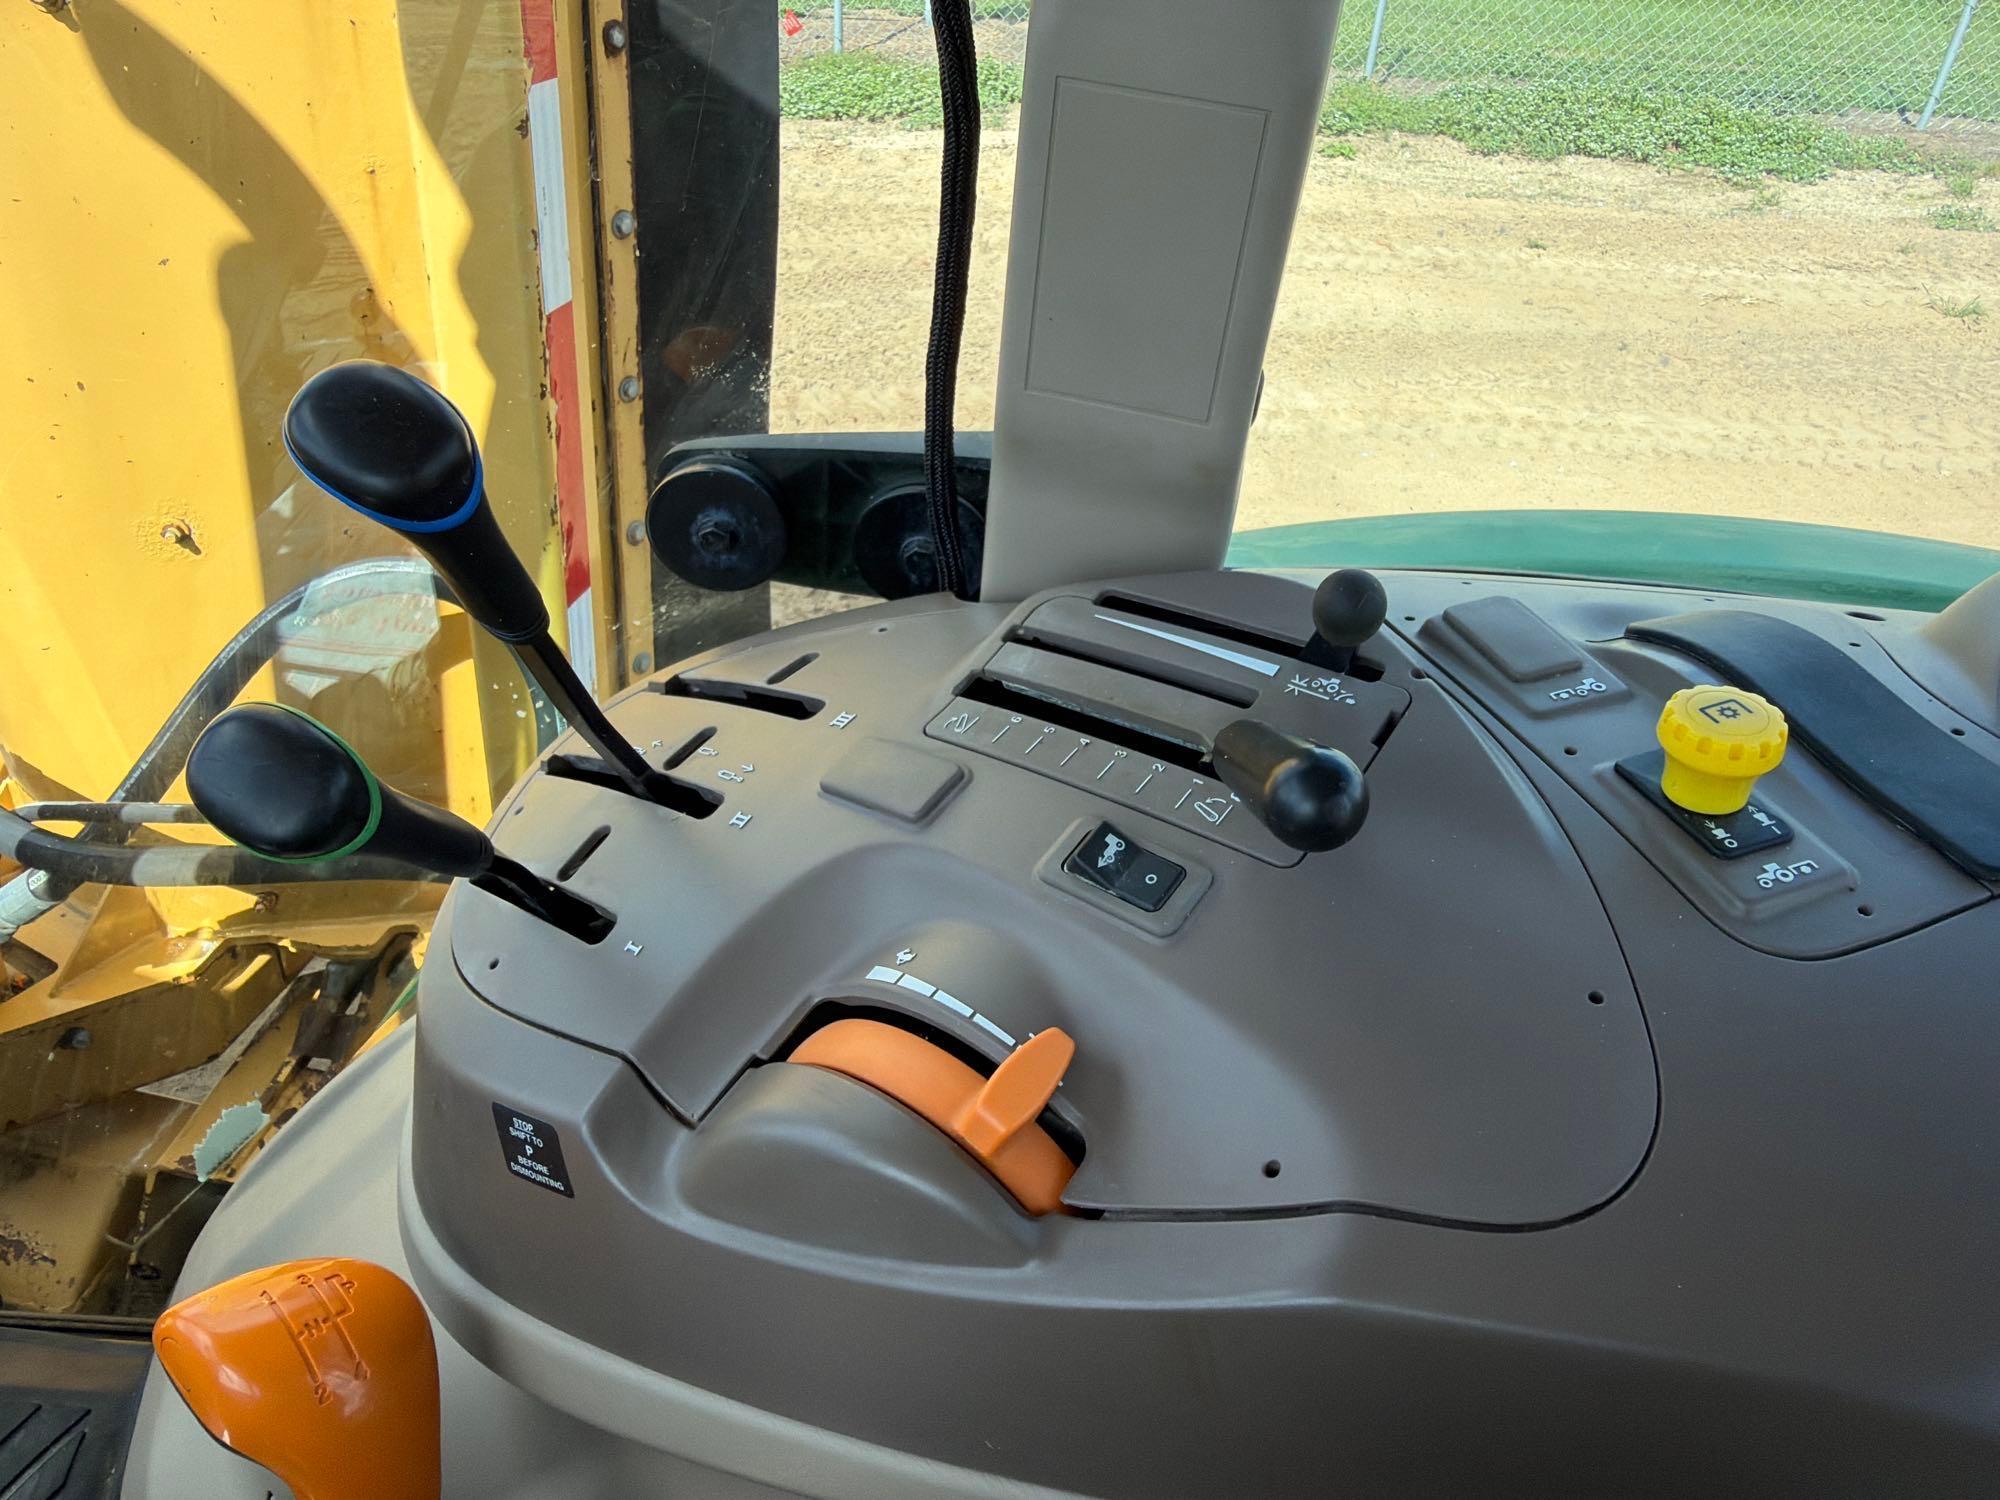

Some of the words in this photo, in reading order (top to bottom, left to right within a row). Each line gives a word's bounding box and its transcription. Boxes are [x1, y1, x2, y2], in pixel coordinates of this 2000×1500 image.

[1044, 726, 1055, 734] 5
[1080, 737, 1090, 746] 4
[1114, 749, 1127, 758] 3
[1152, 763, 1166, 773] 2
[512, 1117, 534, 1135] STOP
[509, 1126, 530, 1143] SHIFT
[531, 1135, 544, 1148] TO
[525, 1144, 533, 1157] P
[517, 1155, 550, 1175] BEFORE
[510, 1161, 565, 1191] DISMOUNTING
[313, 1383, 334, 1407] 2
